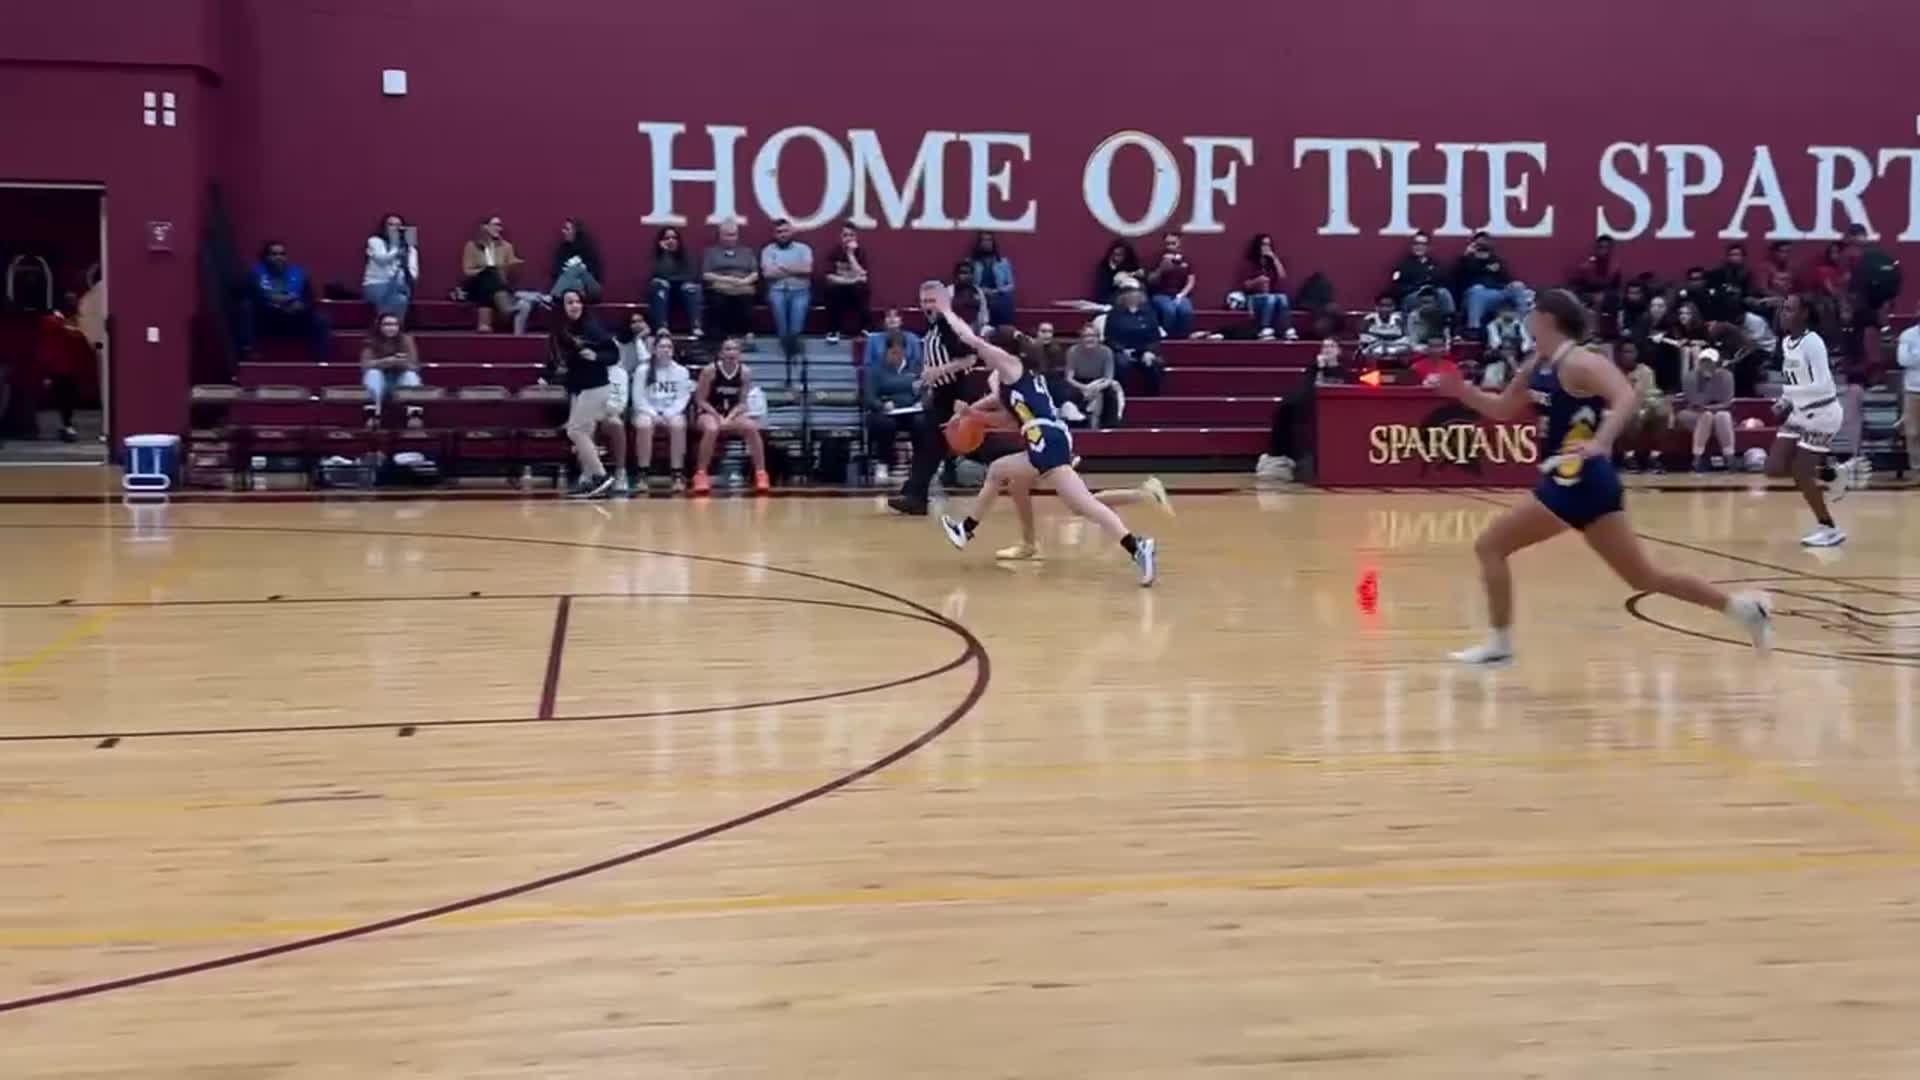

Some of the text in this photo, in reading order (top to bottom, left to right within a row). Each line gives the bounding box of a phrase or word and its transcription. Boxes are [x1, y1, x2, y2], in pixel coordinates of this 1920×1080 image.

[637, 121, 1037, 232] HOME
[1082, 130, 1254, 236] OF
[1293, 137, 1554, 237] THE
[1368, 423, 1538, 465] SPARTANS
